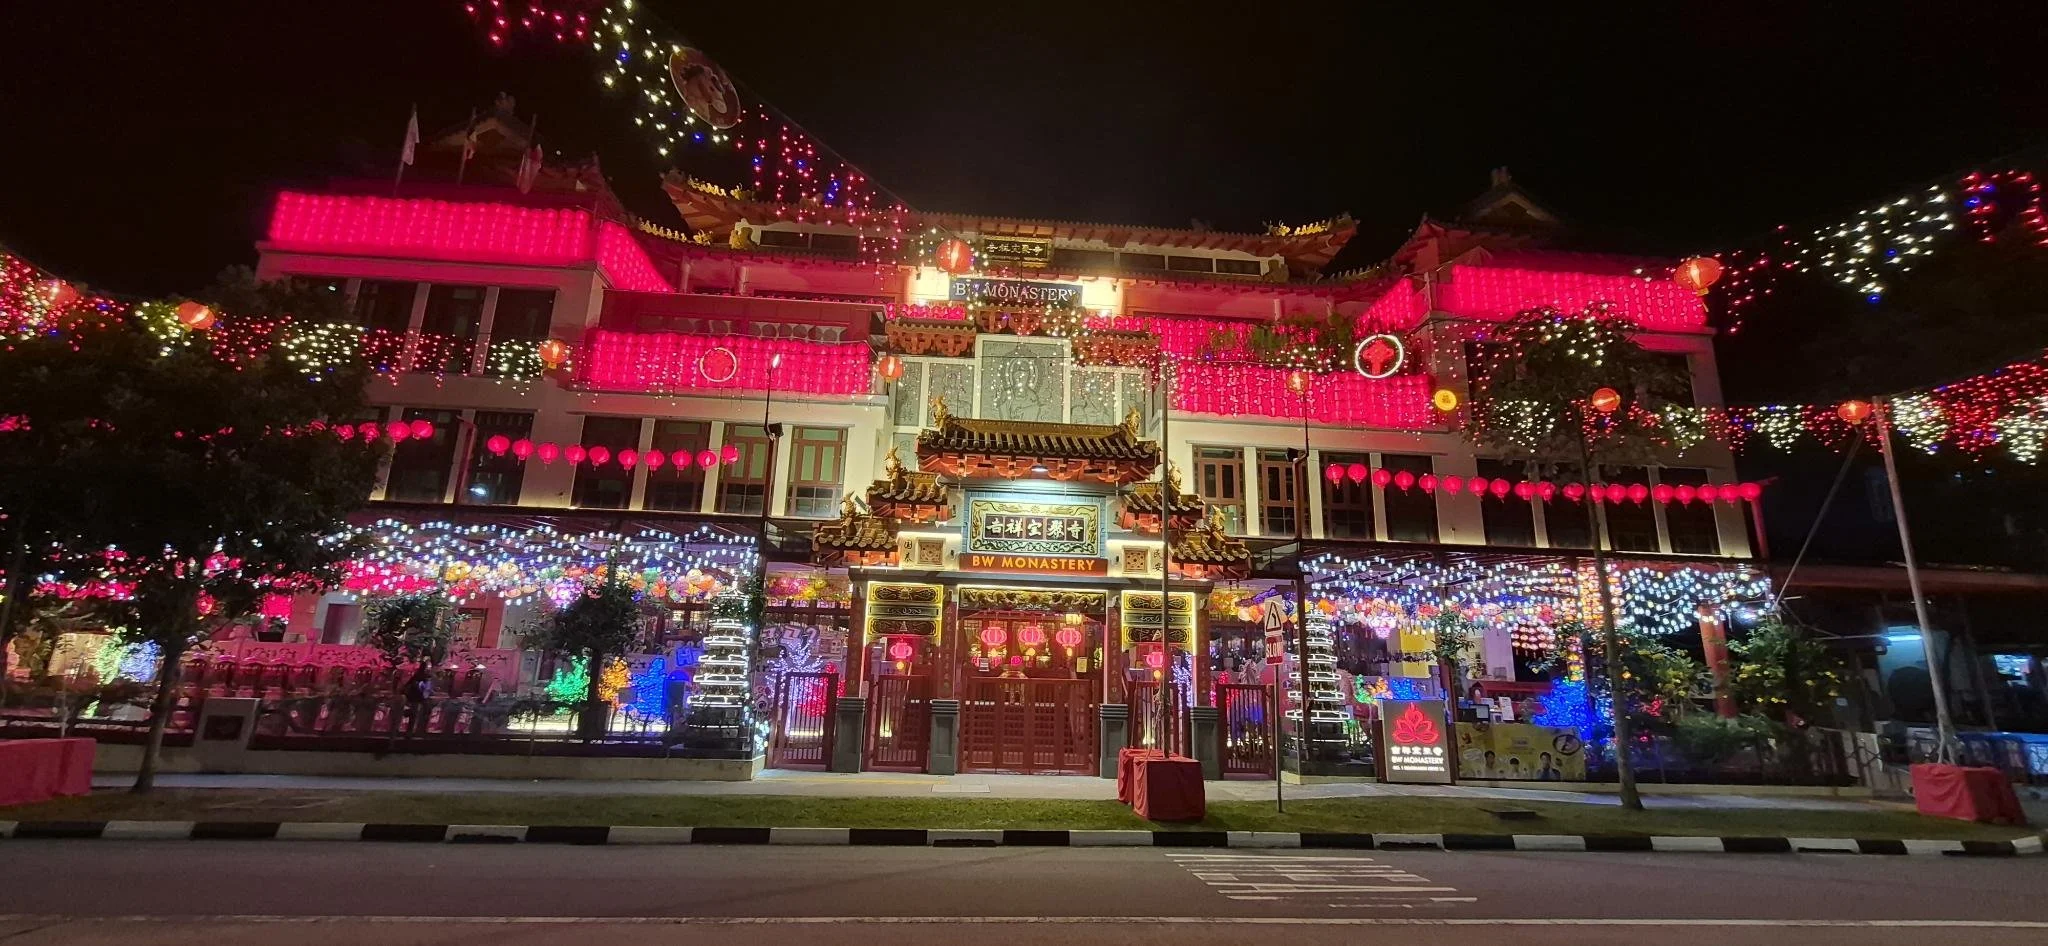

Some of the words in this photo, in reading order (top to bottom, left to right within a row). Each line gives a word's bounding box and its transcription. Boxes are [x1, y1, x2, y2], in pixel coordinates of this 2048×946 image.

[985, 517, 1084, 539] 吉祥宝聚寺
[972, 555, 996, 567] BW
[1001, 556, 1096, 571] MONASTERY
[1266, 641, 1284, 659] SLOW
[1403, 756, 1444, 765] MONASTERY
